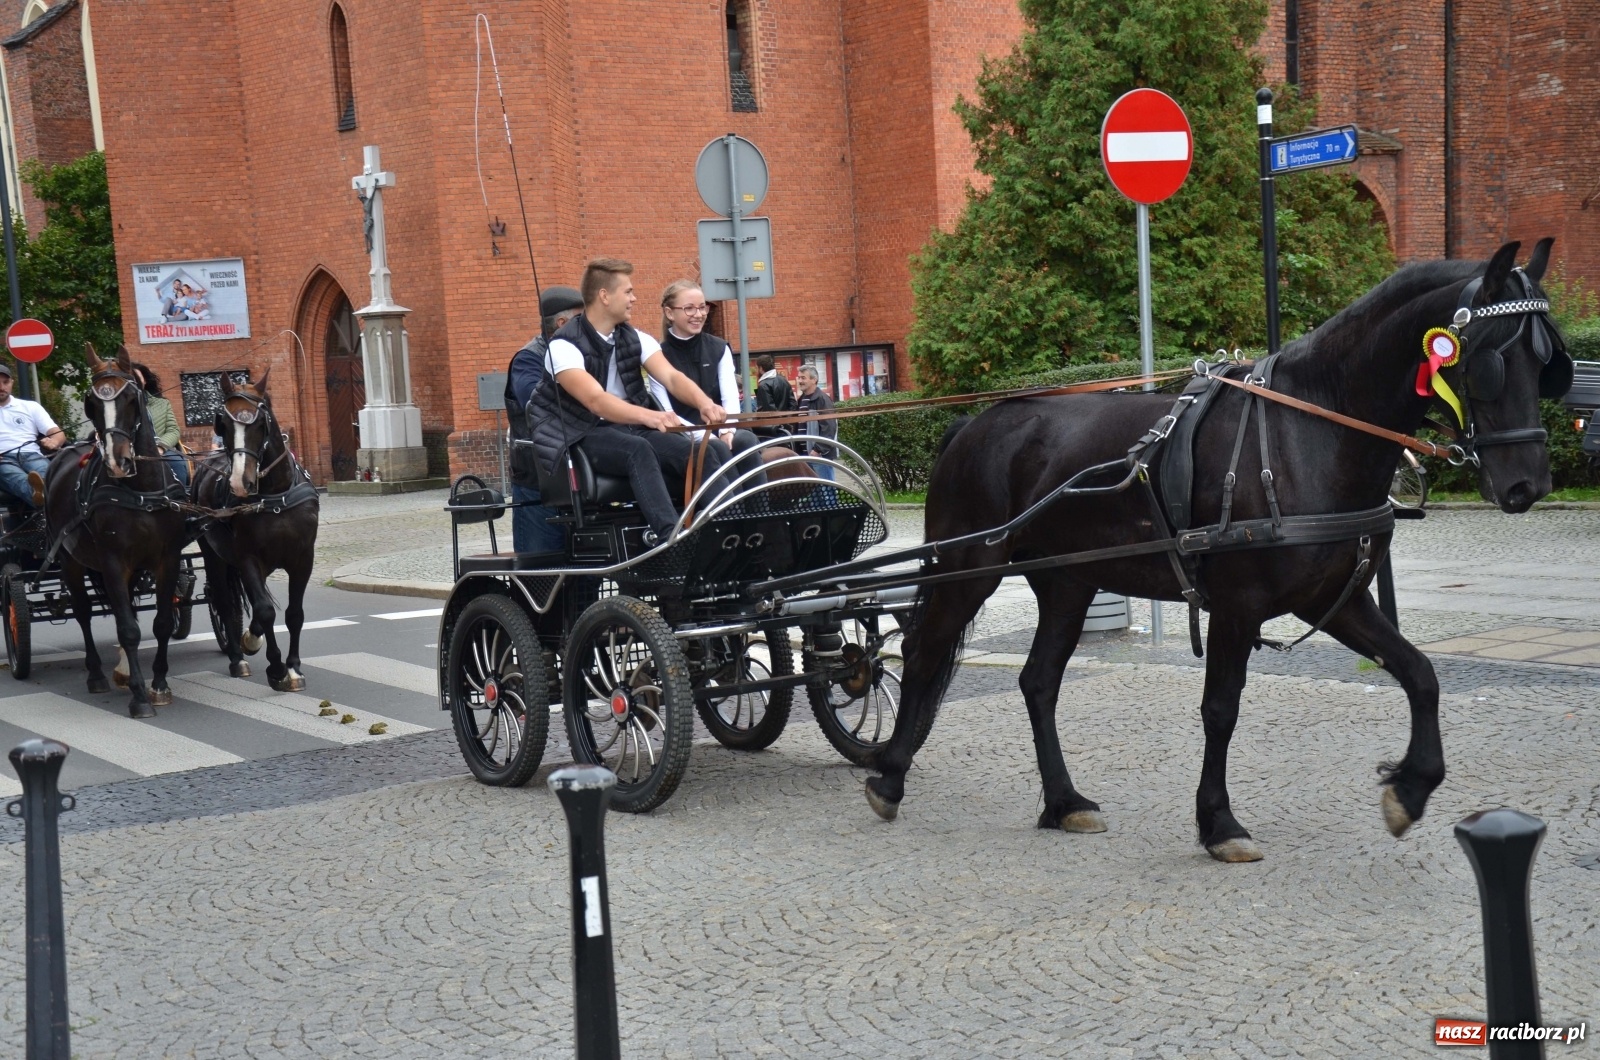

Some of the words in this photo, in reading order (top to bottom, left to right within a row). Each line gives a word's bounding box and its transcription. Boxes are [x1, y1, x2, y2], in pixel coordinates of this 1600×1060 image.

[1290, 139, 1318, 151] Informacja
[1326, 144, 1333, 153] 70
[1290, 153, 1320, 164] Turystyczna
[209, 270, 237, 279] WIECZNOŚĆ
[145, 325, 174, 338] TERAZ
[176, 325, 187, 337] ŻYJ
[189, 324, 235, 337] NAJPIĘKNIEJ!
